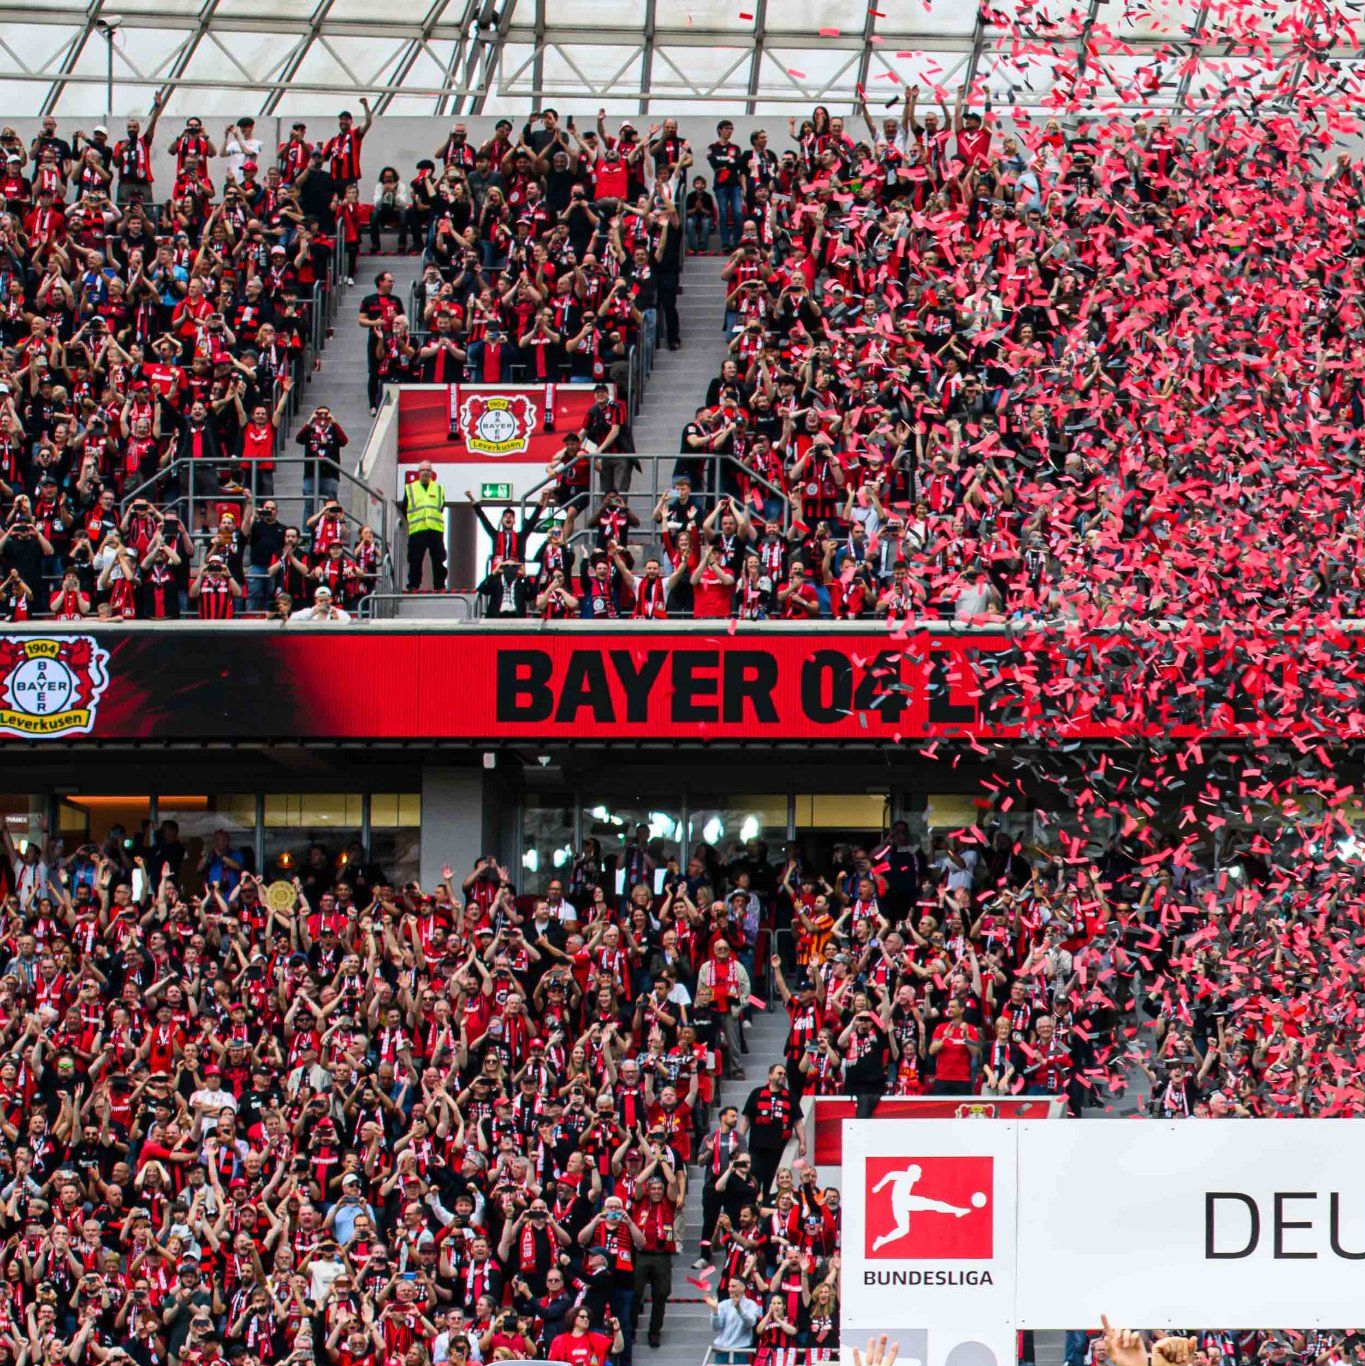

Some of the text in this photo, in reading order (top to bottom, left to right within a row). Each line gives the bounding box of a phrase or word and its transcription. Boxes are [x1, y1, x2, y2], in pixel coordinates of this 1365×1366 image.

[472, 440, 521, 452] Leverkusen
[27, 643, 56, 655] 1904
[17, 682, 67, 691] BAYER
[496, 650, 780, 724] BAYER
[801, 650, 904, 724] 04
[0, 713, 82, 731] Leverkusen
[865, 1271, 993, 1286] BUNDESLIGA
